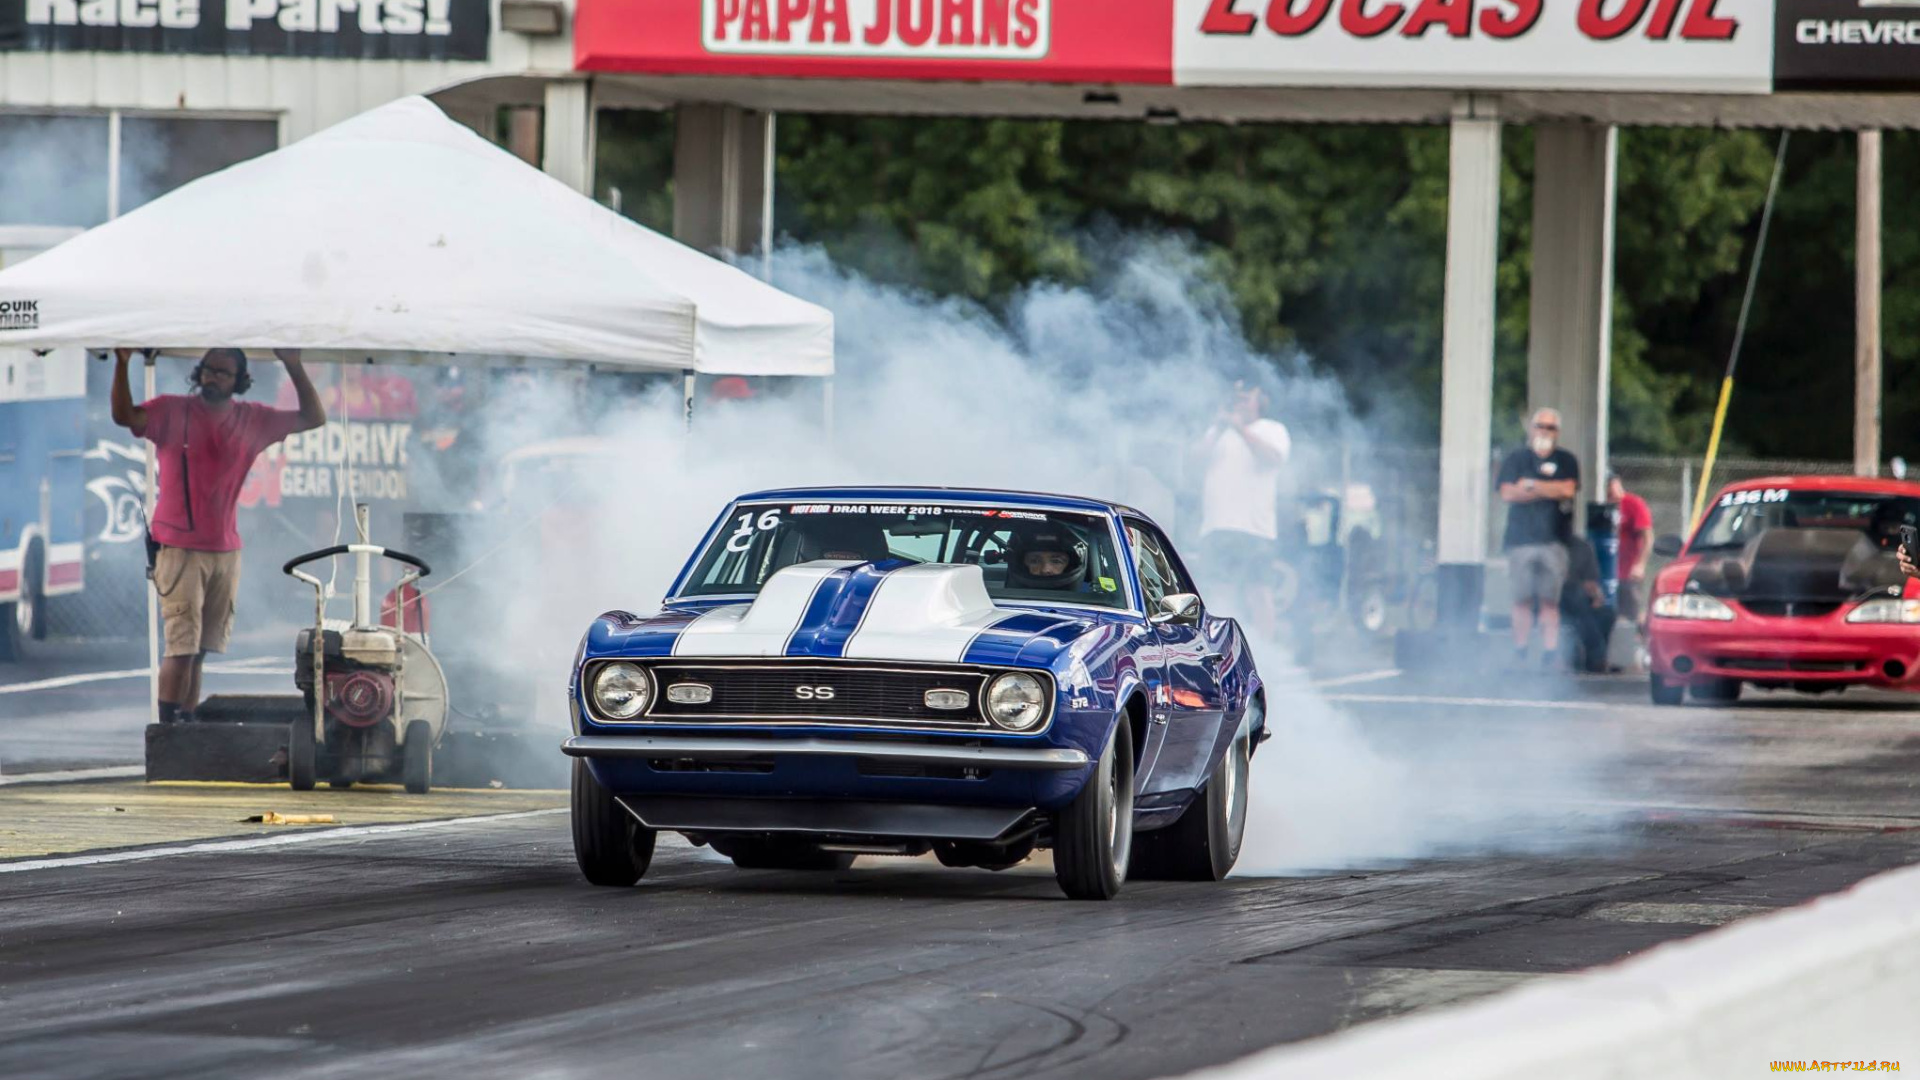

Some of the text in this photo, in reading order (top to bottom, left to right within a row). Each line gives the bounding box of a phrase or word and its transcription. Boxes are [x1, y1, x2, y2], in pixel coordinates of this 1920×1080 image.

[280, 467, 331, 497] GEAR
[832, 505, 868, 514] DRAG
[870, 505, 906, 514] WEEK
[909, 506, 942, 515] 2018
[734, 508, 781, 535] 16
[726, 532, 751, 552] C
[796, 685, 835, 699] SS
[1072, 697, 1089, 709] 572
